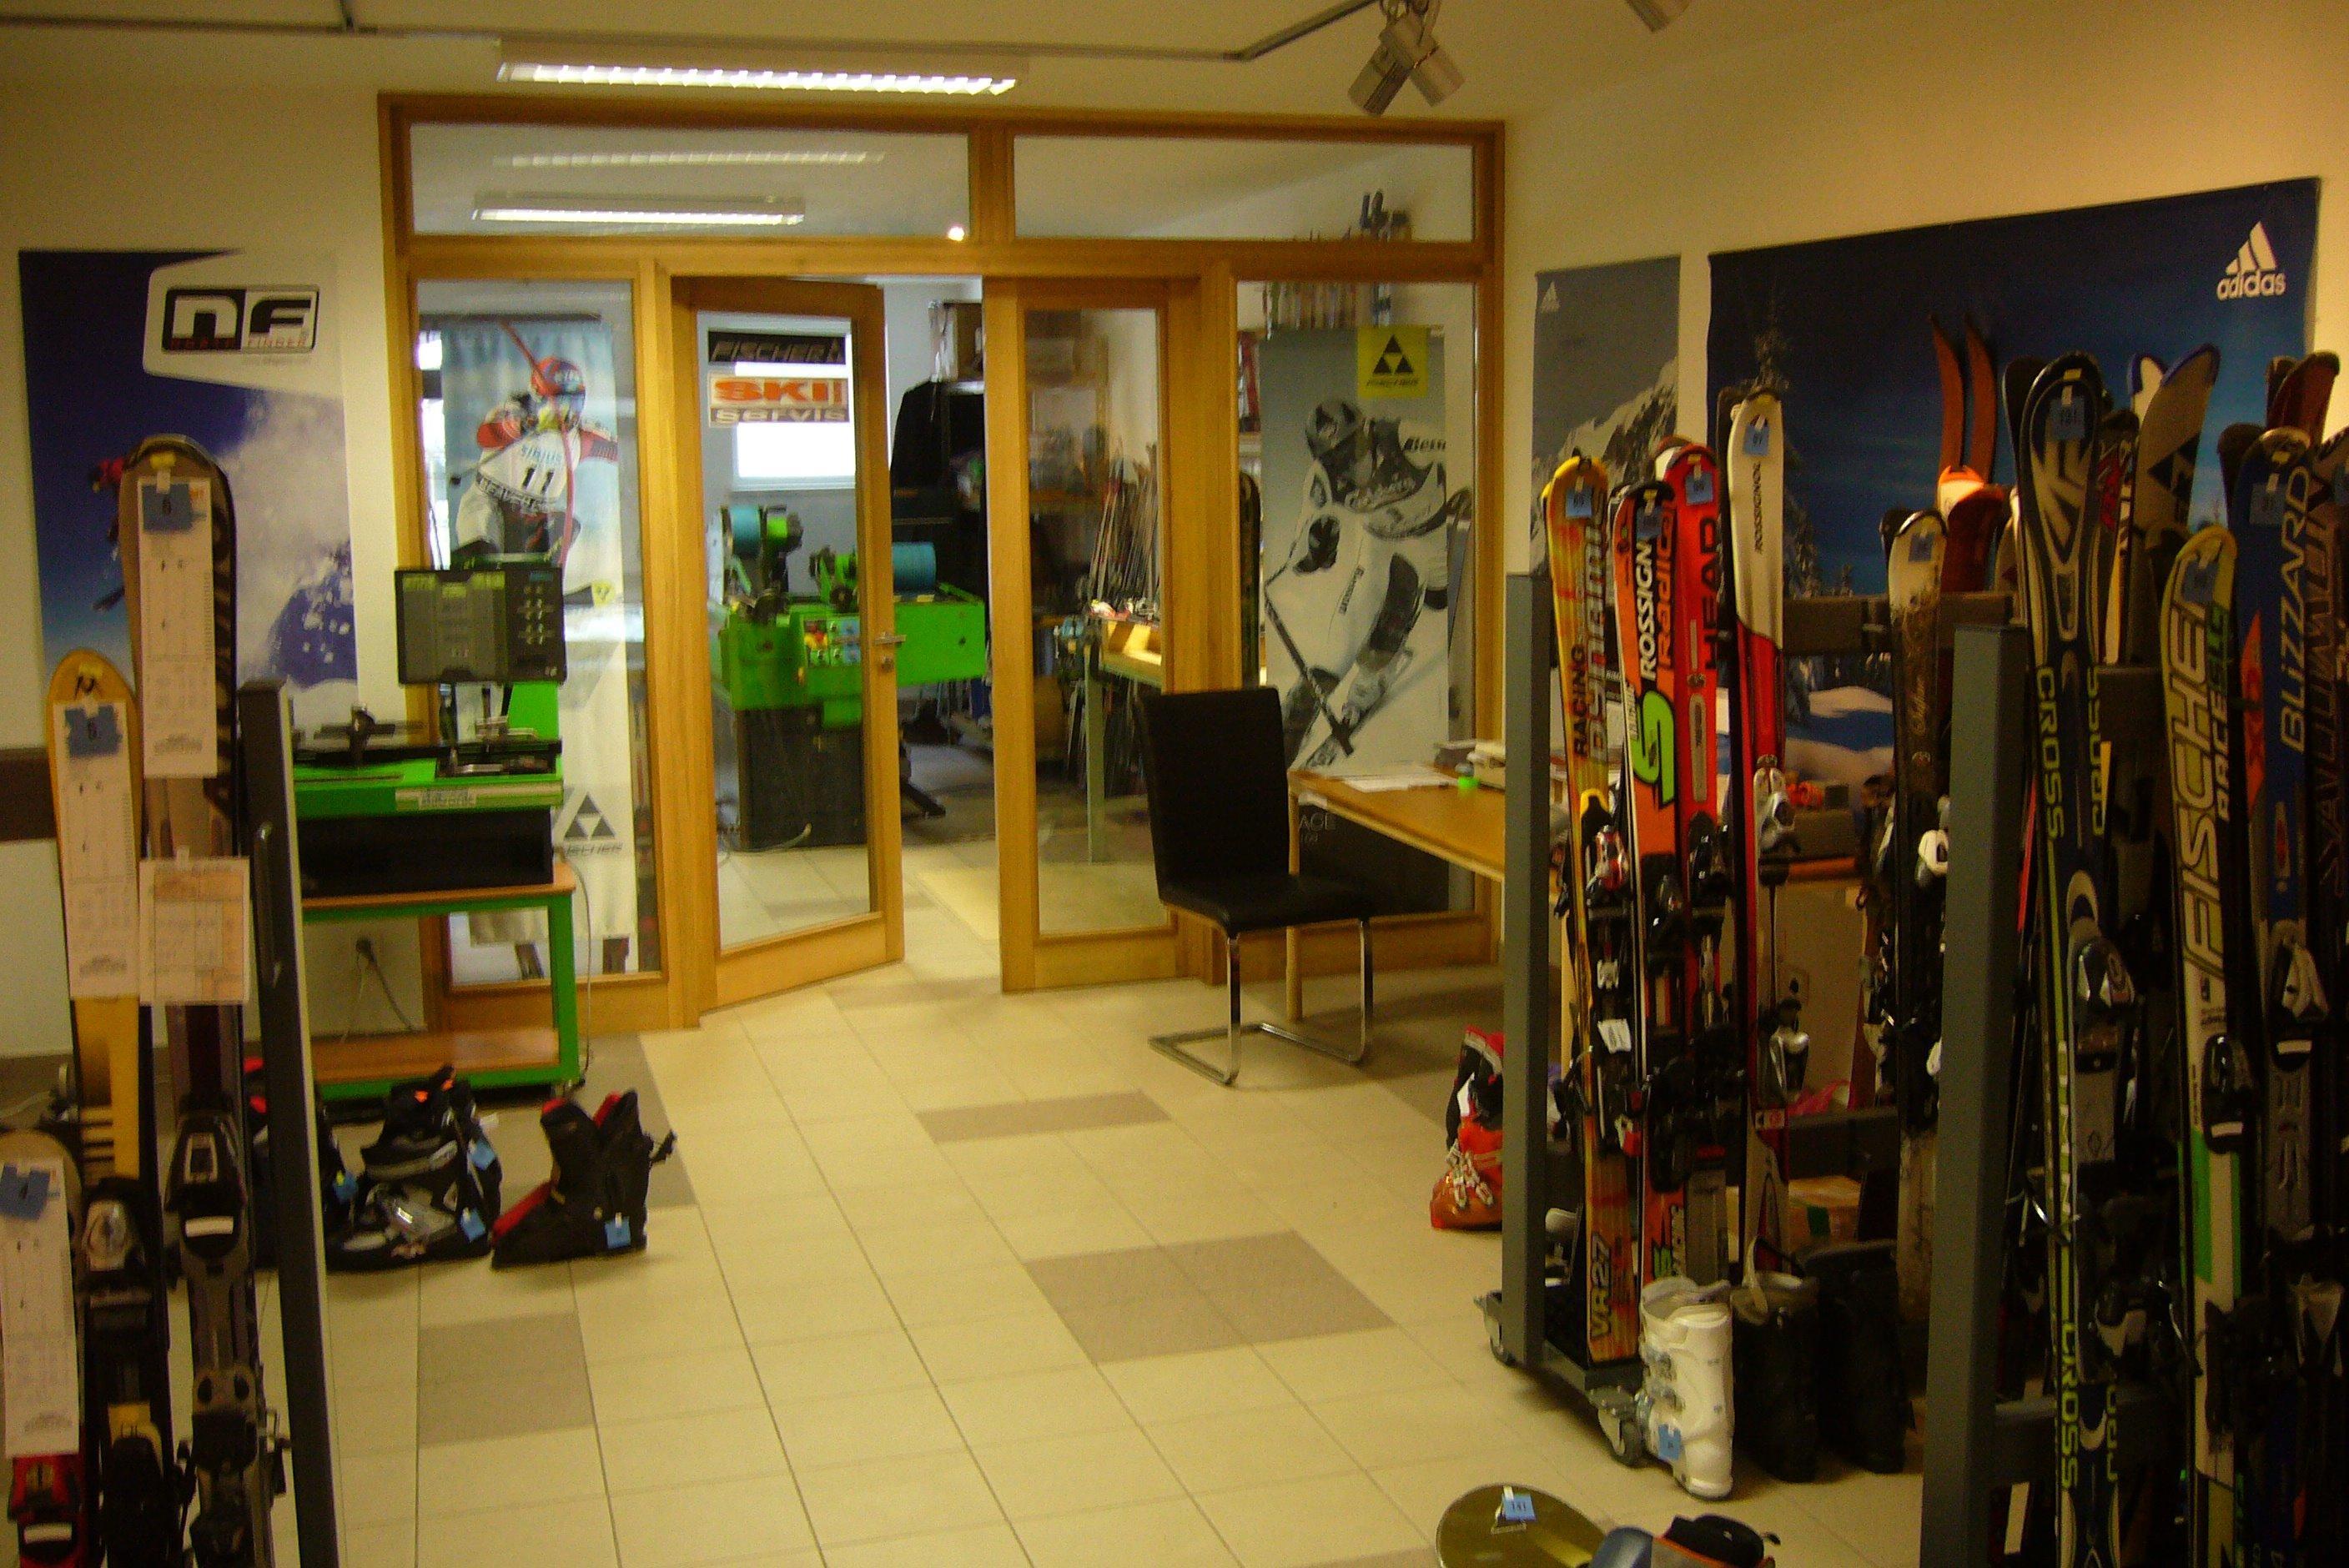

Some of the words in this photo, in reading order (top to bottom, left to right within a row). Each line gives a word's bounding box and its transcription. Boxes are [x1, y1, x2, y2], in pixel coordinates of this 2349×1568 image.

[2216, 271, 2286, 301] adidas
[522, 466, 555, 495] 11
[1636, 538, 1657, 681] ROSSIGN
[1700, 518, 1718, 670] HEAD
[2280, 465, 2310, 751] BLIZZARD
[1571, 642, 1589, 757] RACING
[2036, 667, 2065, 838] CROSS
